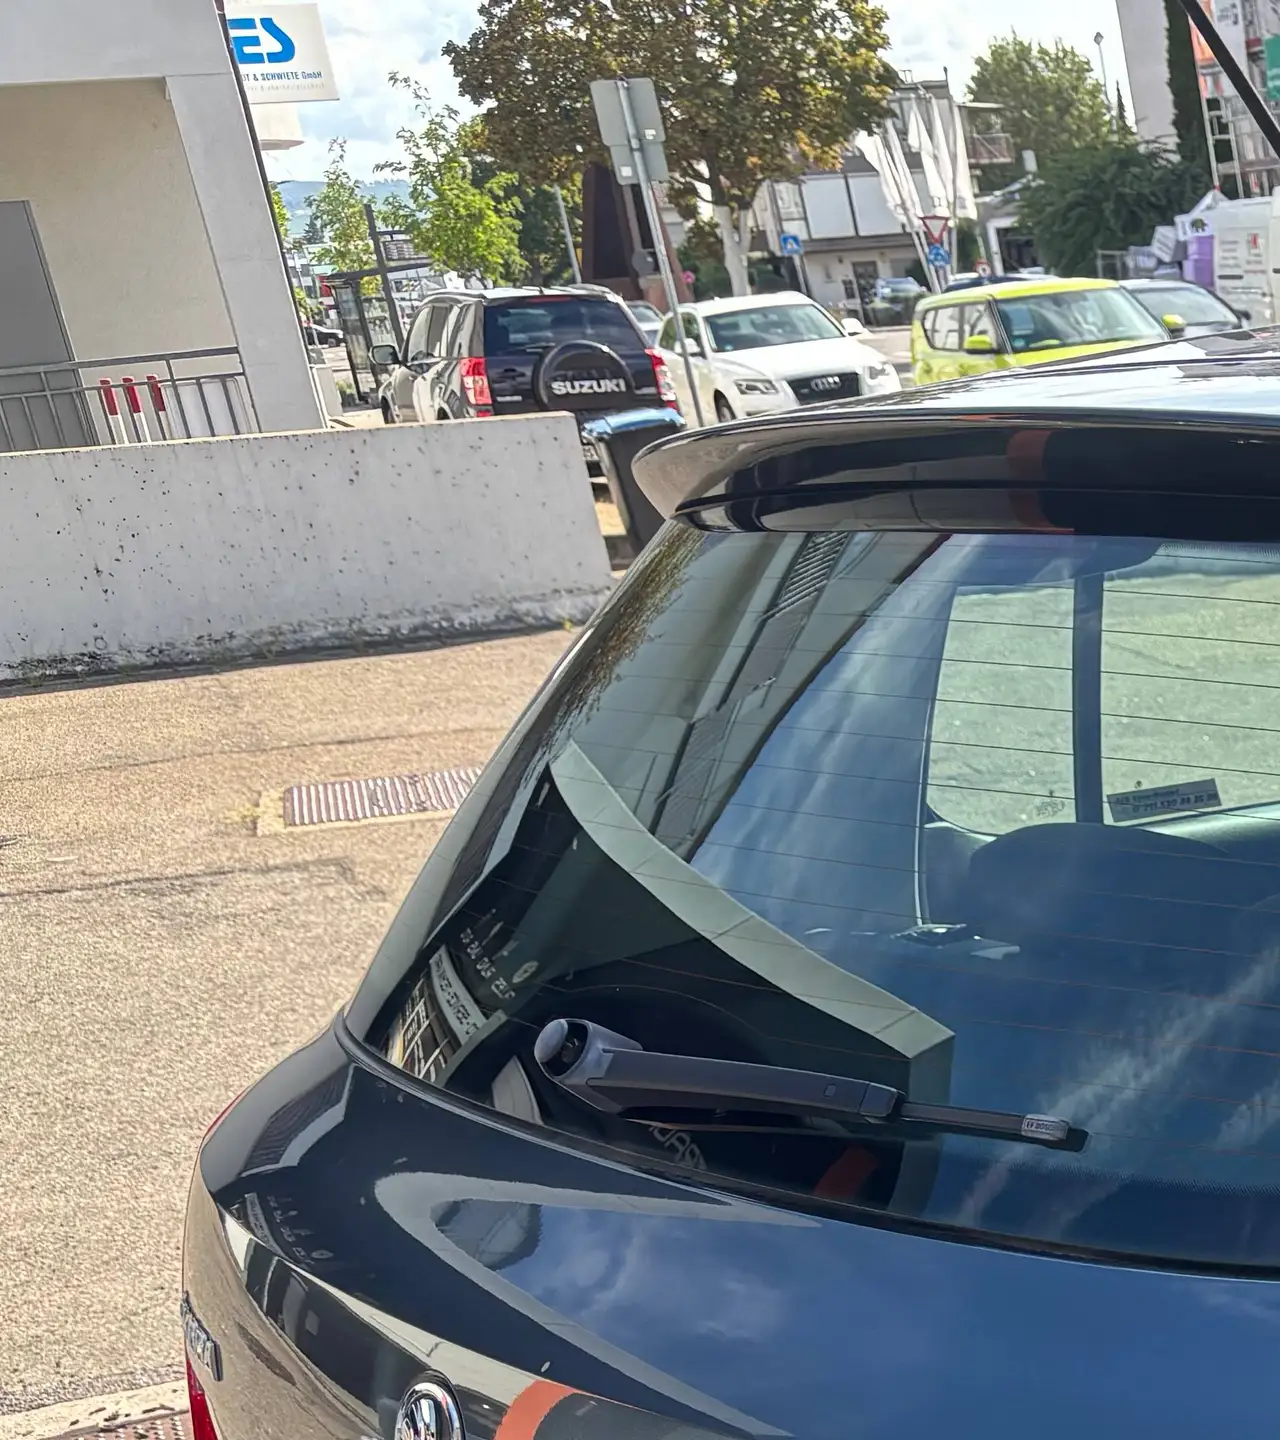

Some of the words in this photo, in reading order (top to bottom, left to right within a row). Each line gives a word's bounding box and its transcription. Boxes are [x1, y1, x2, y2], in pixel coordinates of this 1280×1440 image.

[261, 71, 300, 81] SCHWIETE
[301, 71, 322, 80] GmbH
[551, 378, 627, 395] SUZUKI
